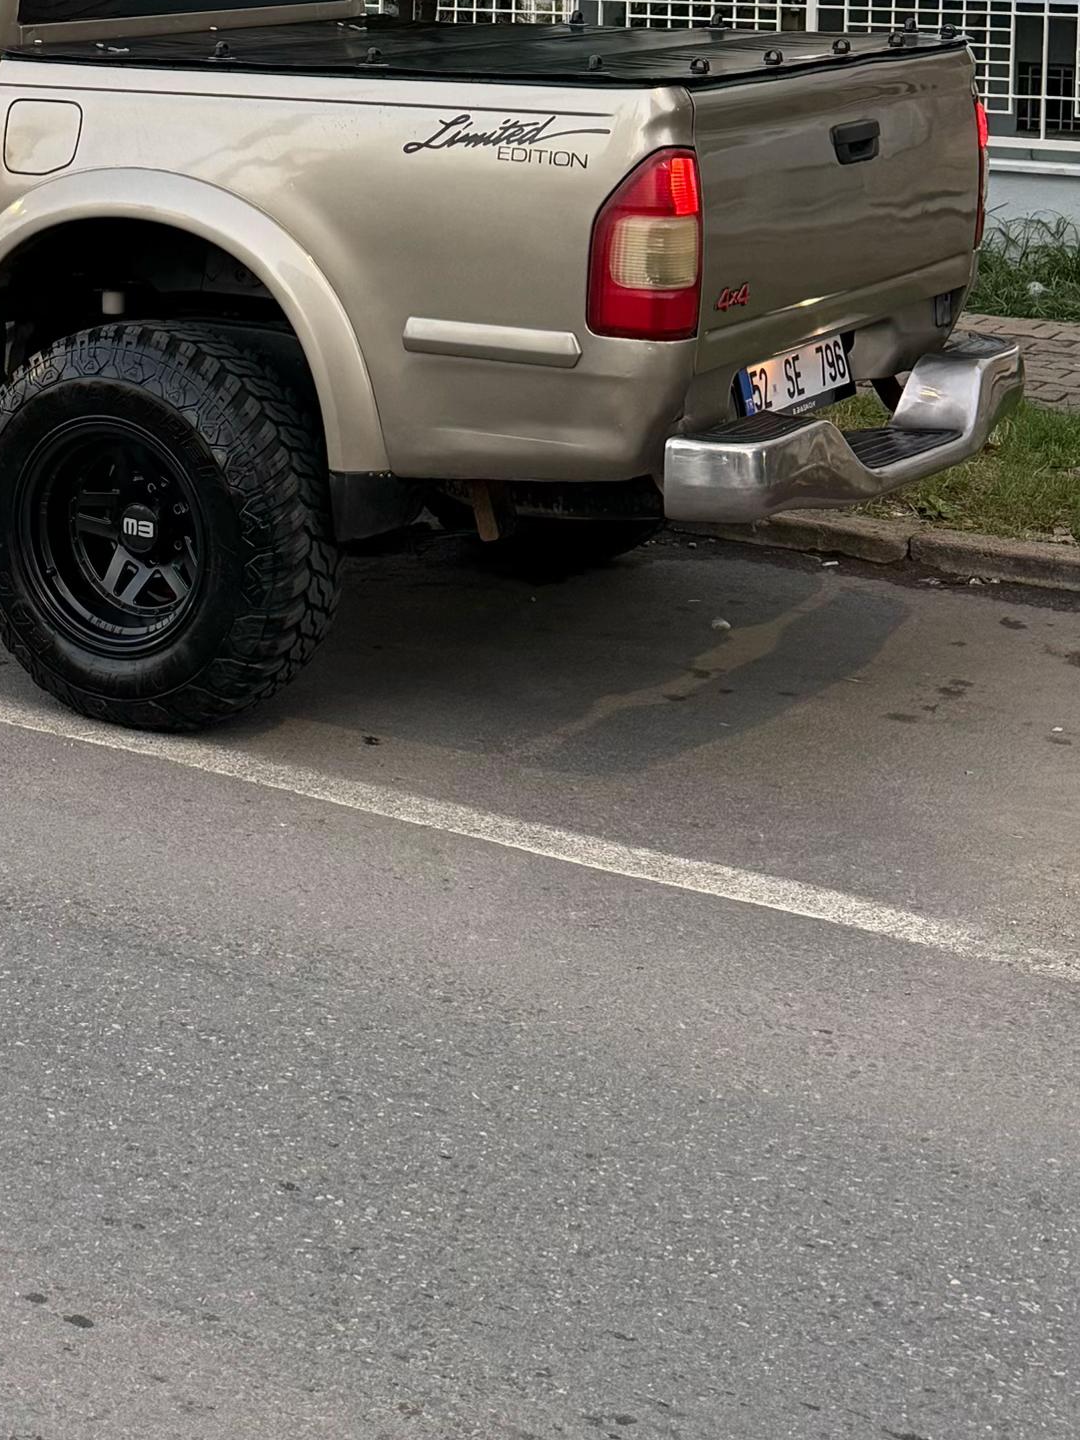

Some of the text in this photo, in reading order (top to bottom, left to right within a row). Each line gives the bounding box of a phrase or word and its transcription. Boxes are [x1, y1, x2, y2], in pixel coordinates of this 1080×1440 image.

[403, 114, 611, 154] Limited
[497, 146, 589, 169] EDITION
[749, 340, 847, 410] 52 SE 796
